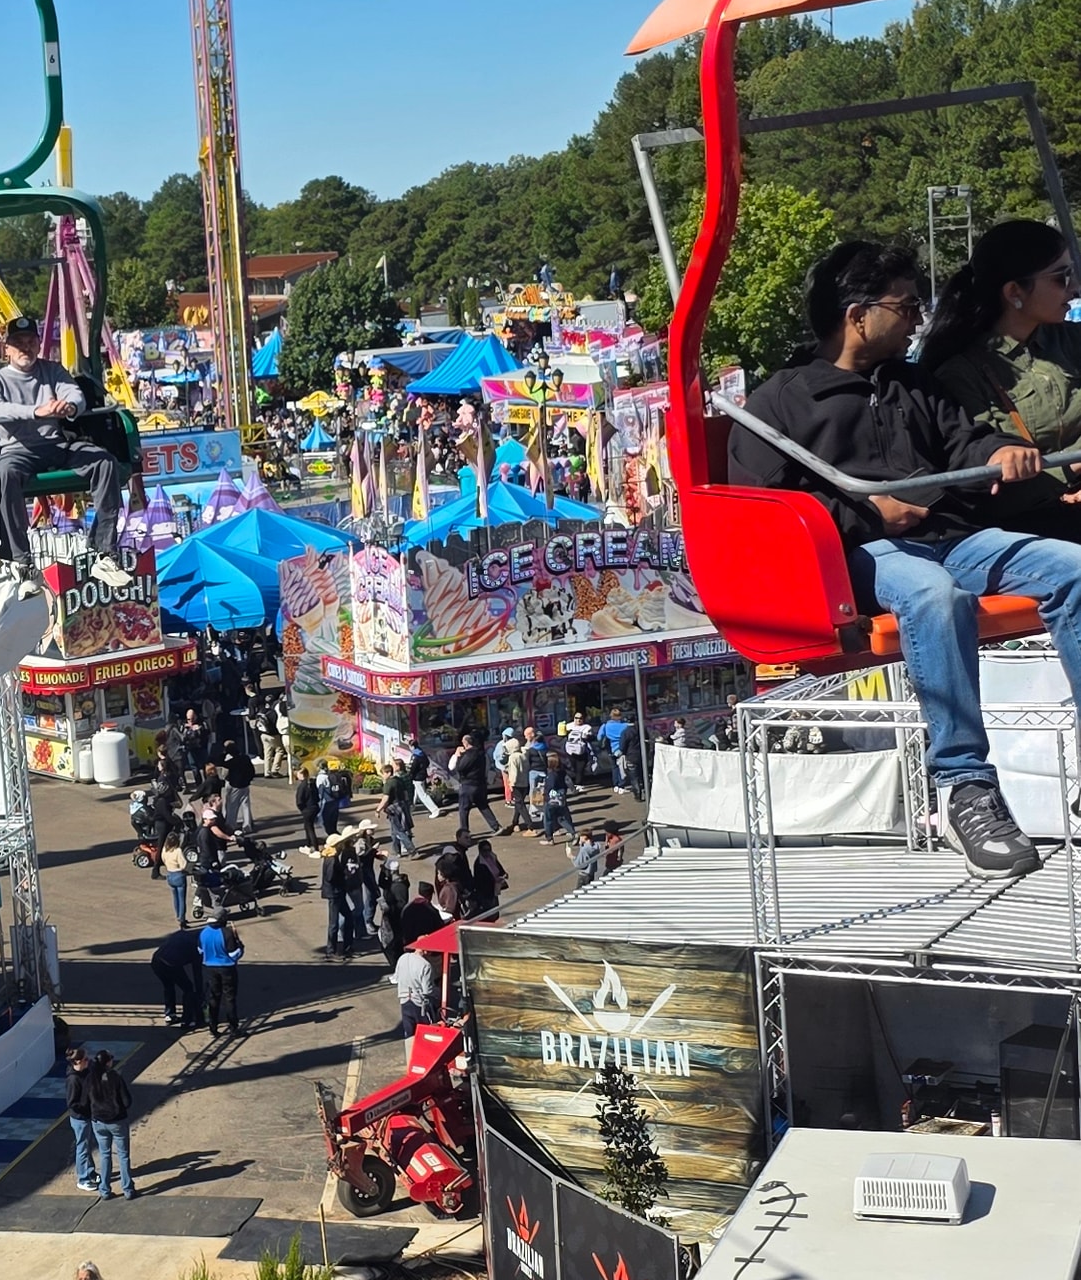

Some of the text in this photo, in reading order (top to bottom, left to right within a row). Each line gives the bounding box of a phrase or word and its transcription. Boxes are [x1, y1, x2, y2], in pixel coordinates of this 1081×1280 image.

[49, 54, 56, 64] 6
[141, 441, 200, 475] ETS
[466, 529, 689, 600] ICE CREAM
[560, 655, 591, 674] CONES
[594, 654, 602, 670] &
[672, 643, 693, 660] FRESH
[35, 671, 85, 685] LEMONADE
[95, 653, 175, 682] FRIED OREOS
[441, 674, 456, 691] HOT
[458, 669, 498, 689] CHOCOLATE
[508, 664, 535, 682] COFFEE
[540, 1030, 691, 1078] BRAZILIAN
[506, 1226, 544, 1280] BRAZILIAN
